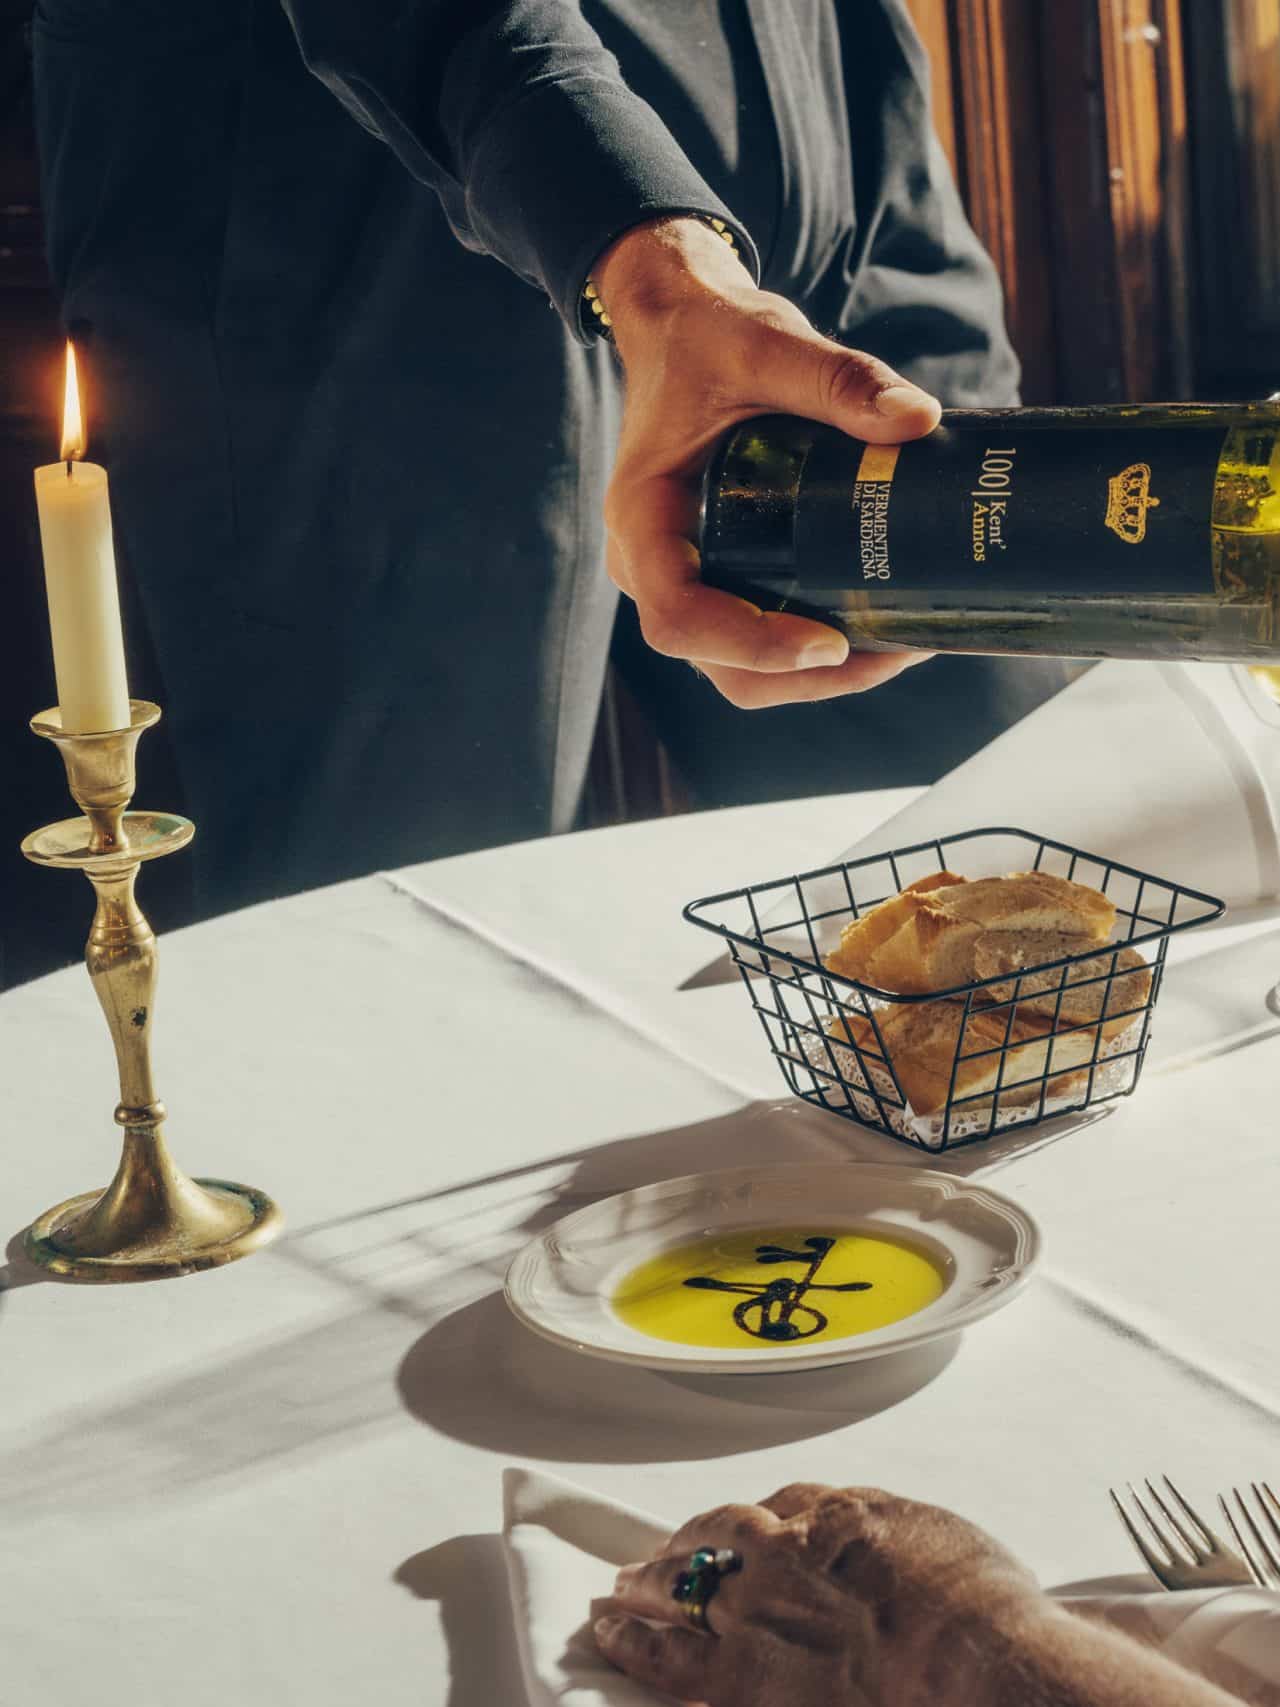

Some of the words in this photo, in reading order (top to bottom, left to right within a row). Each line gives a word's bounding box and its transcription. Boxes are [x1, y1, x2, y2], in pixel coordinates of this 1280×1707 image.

[863, 483, 877, 498] DI
[860, 501, 876, 580] SARDEGNA
[874, 483, 891, 580] VERMENTINO
[973, 501, 988, 561] Annos
